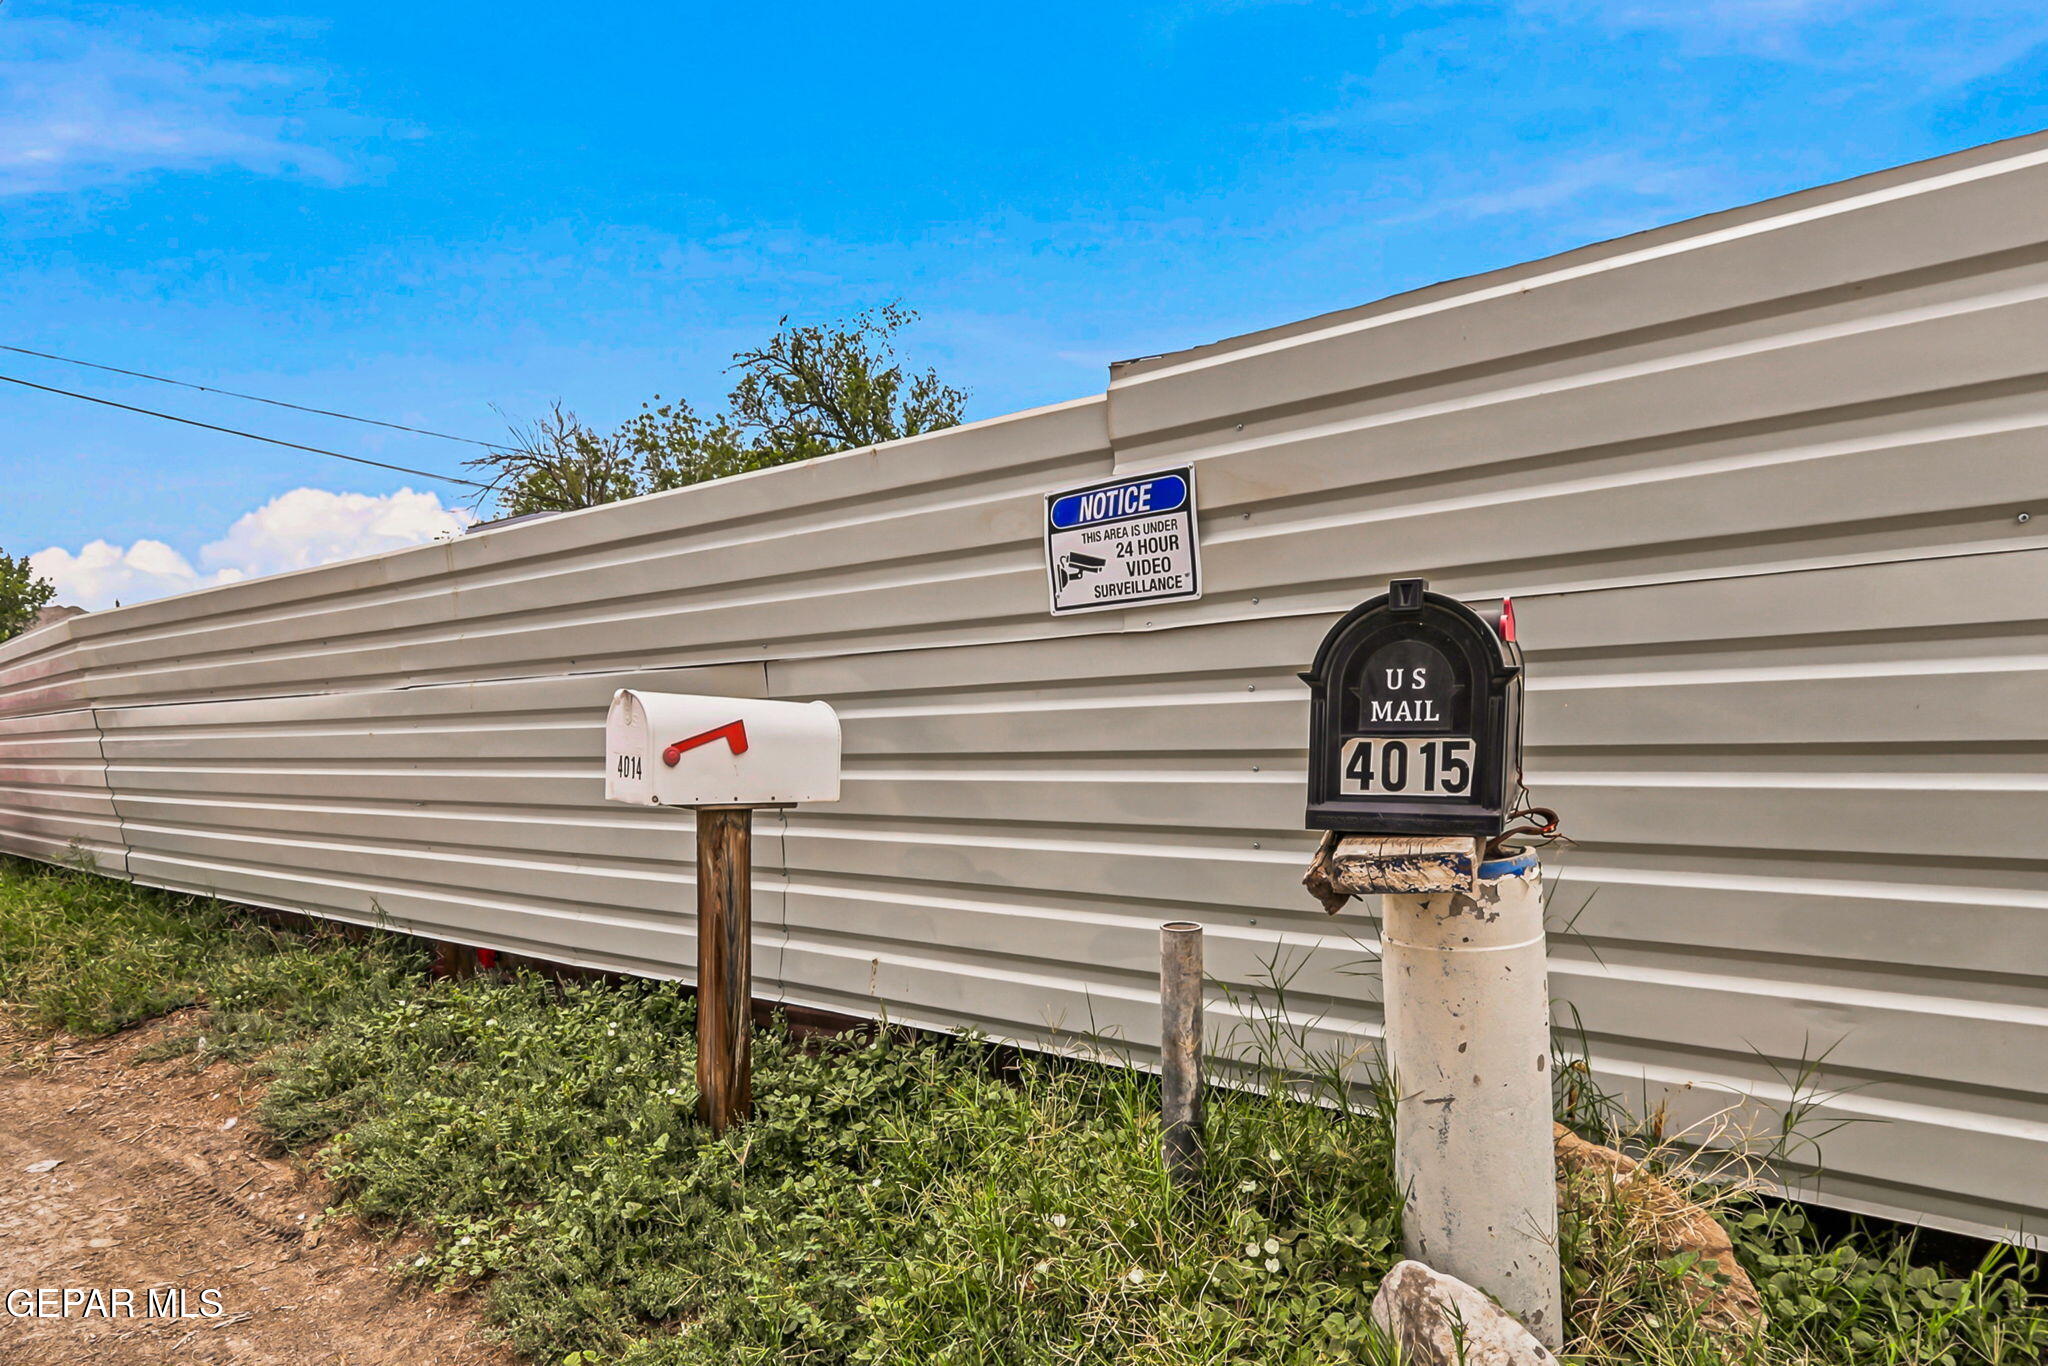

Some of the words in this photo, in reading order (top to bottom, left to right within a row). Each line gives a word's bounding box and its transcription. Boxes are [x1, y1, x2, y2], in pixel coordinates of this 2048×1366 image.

[1079, 483, 1153, 522] NOTICE
[1081, 531, 1102, 544] THIS
[1103, 527, 1129, 541] AREA
[1131, 525, 1141, 537] IS
[1143, 518, 1178, 535] UNDER
[1116, 540, 1134, 558] 24
[1137, 534, 1179, 555] HOUR
[1126, 556, 1171, 577] VIDEO
[1094, 575, 1183, 599] SURVEILLANCE
[1370, 699, 1440, 722] MAIL
[617, 755, 642, 780] 4014
[1345, 740, 1470, 794] 4015
